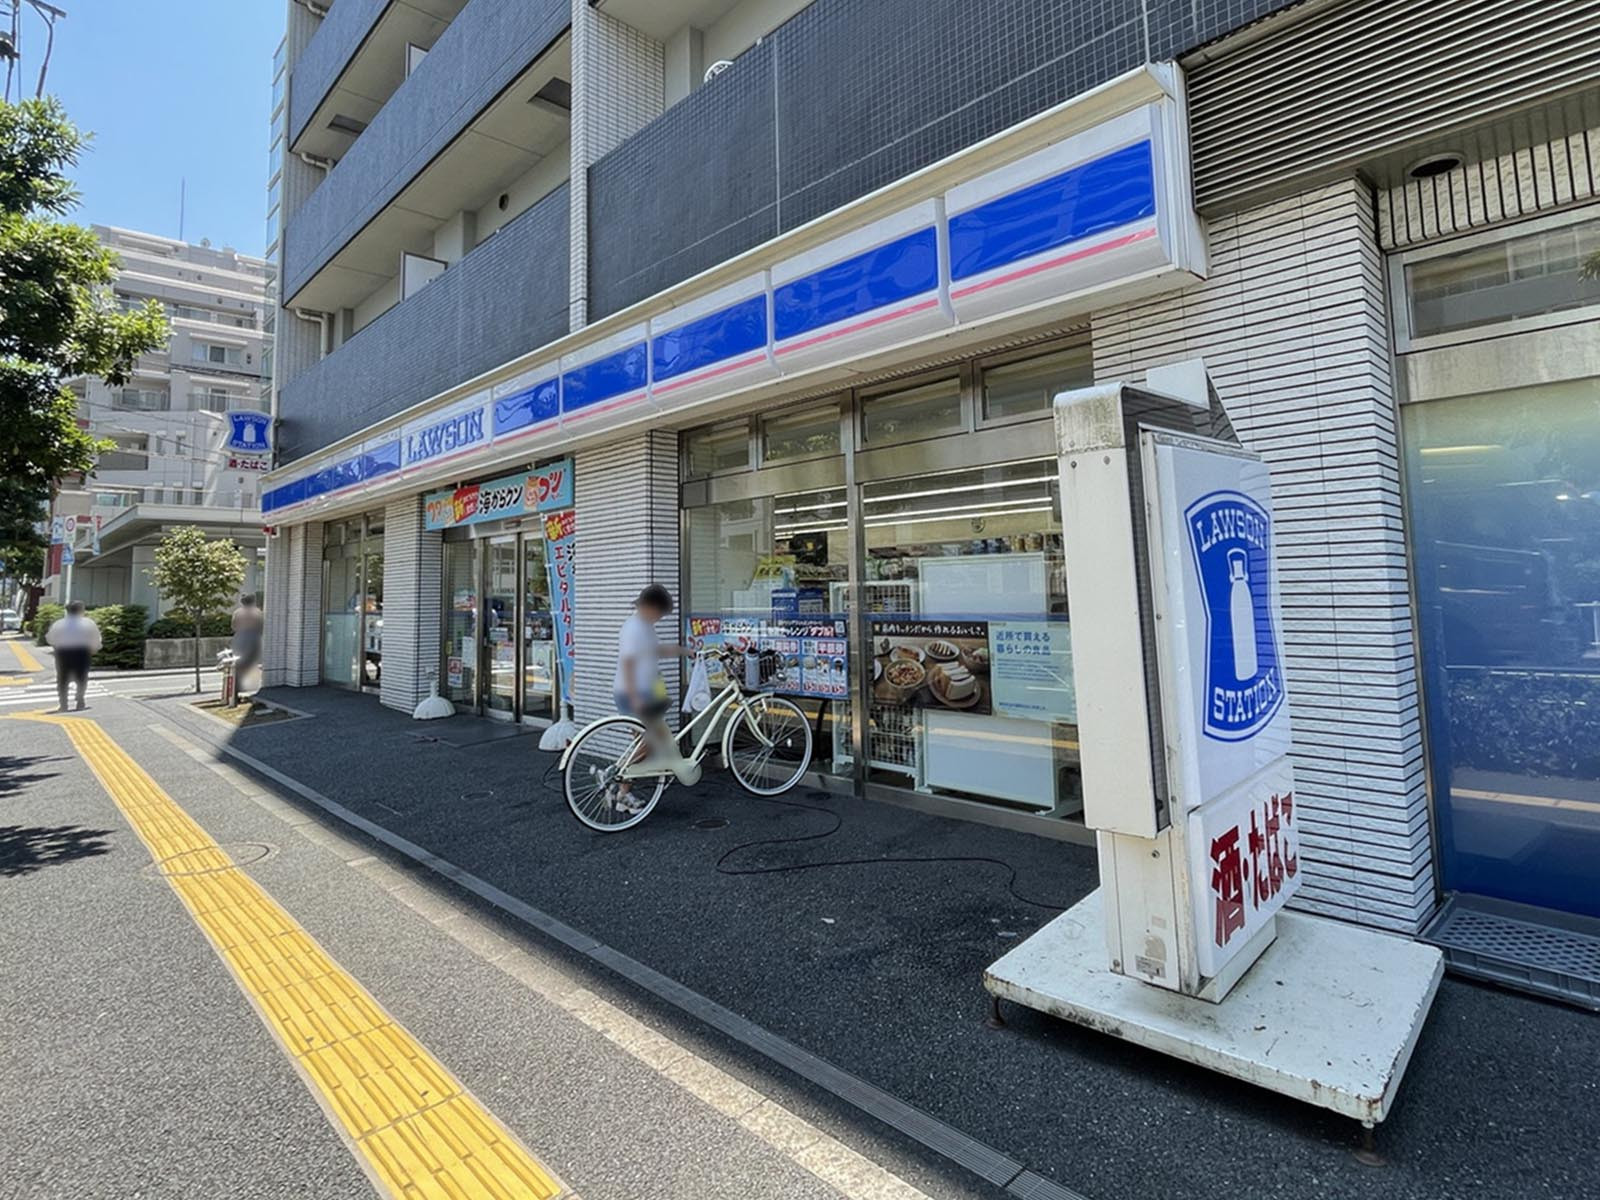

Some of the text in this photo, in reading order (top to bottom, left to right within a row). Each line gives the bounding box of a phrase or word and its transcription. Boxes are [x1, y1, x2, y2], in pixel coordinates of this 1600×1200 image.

[233, 414, 267, 425] LAWSON
[406, 407, 484, 463] LAWSON
[479, 485, 523, 515] 海からクン
[1196, 508, 1266, 552] LAWSON
[996, 631, 1050, 643] 近所で買える
[1213, 667, 1278, 723] STATION
[1210, 791, 1298, 948] 酒・たばこ
